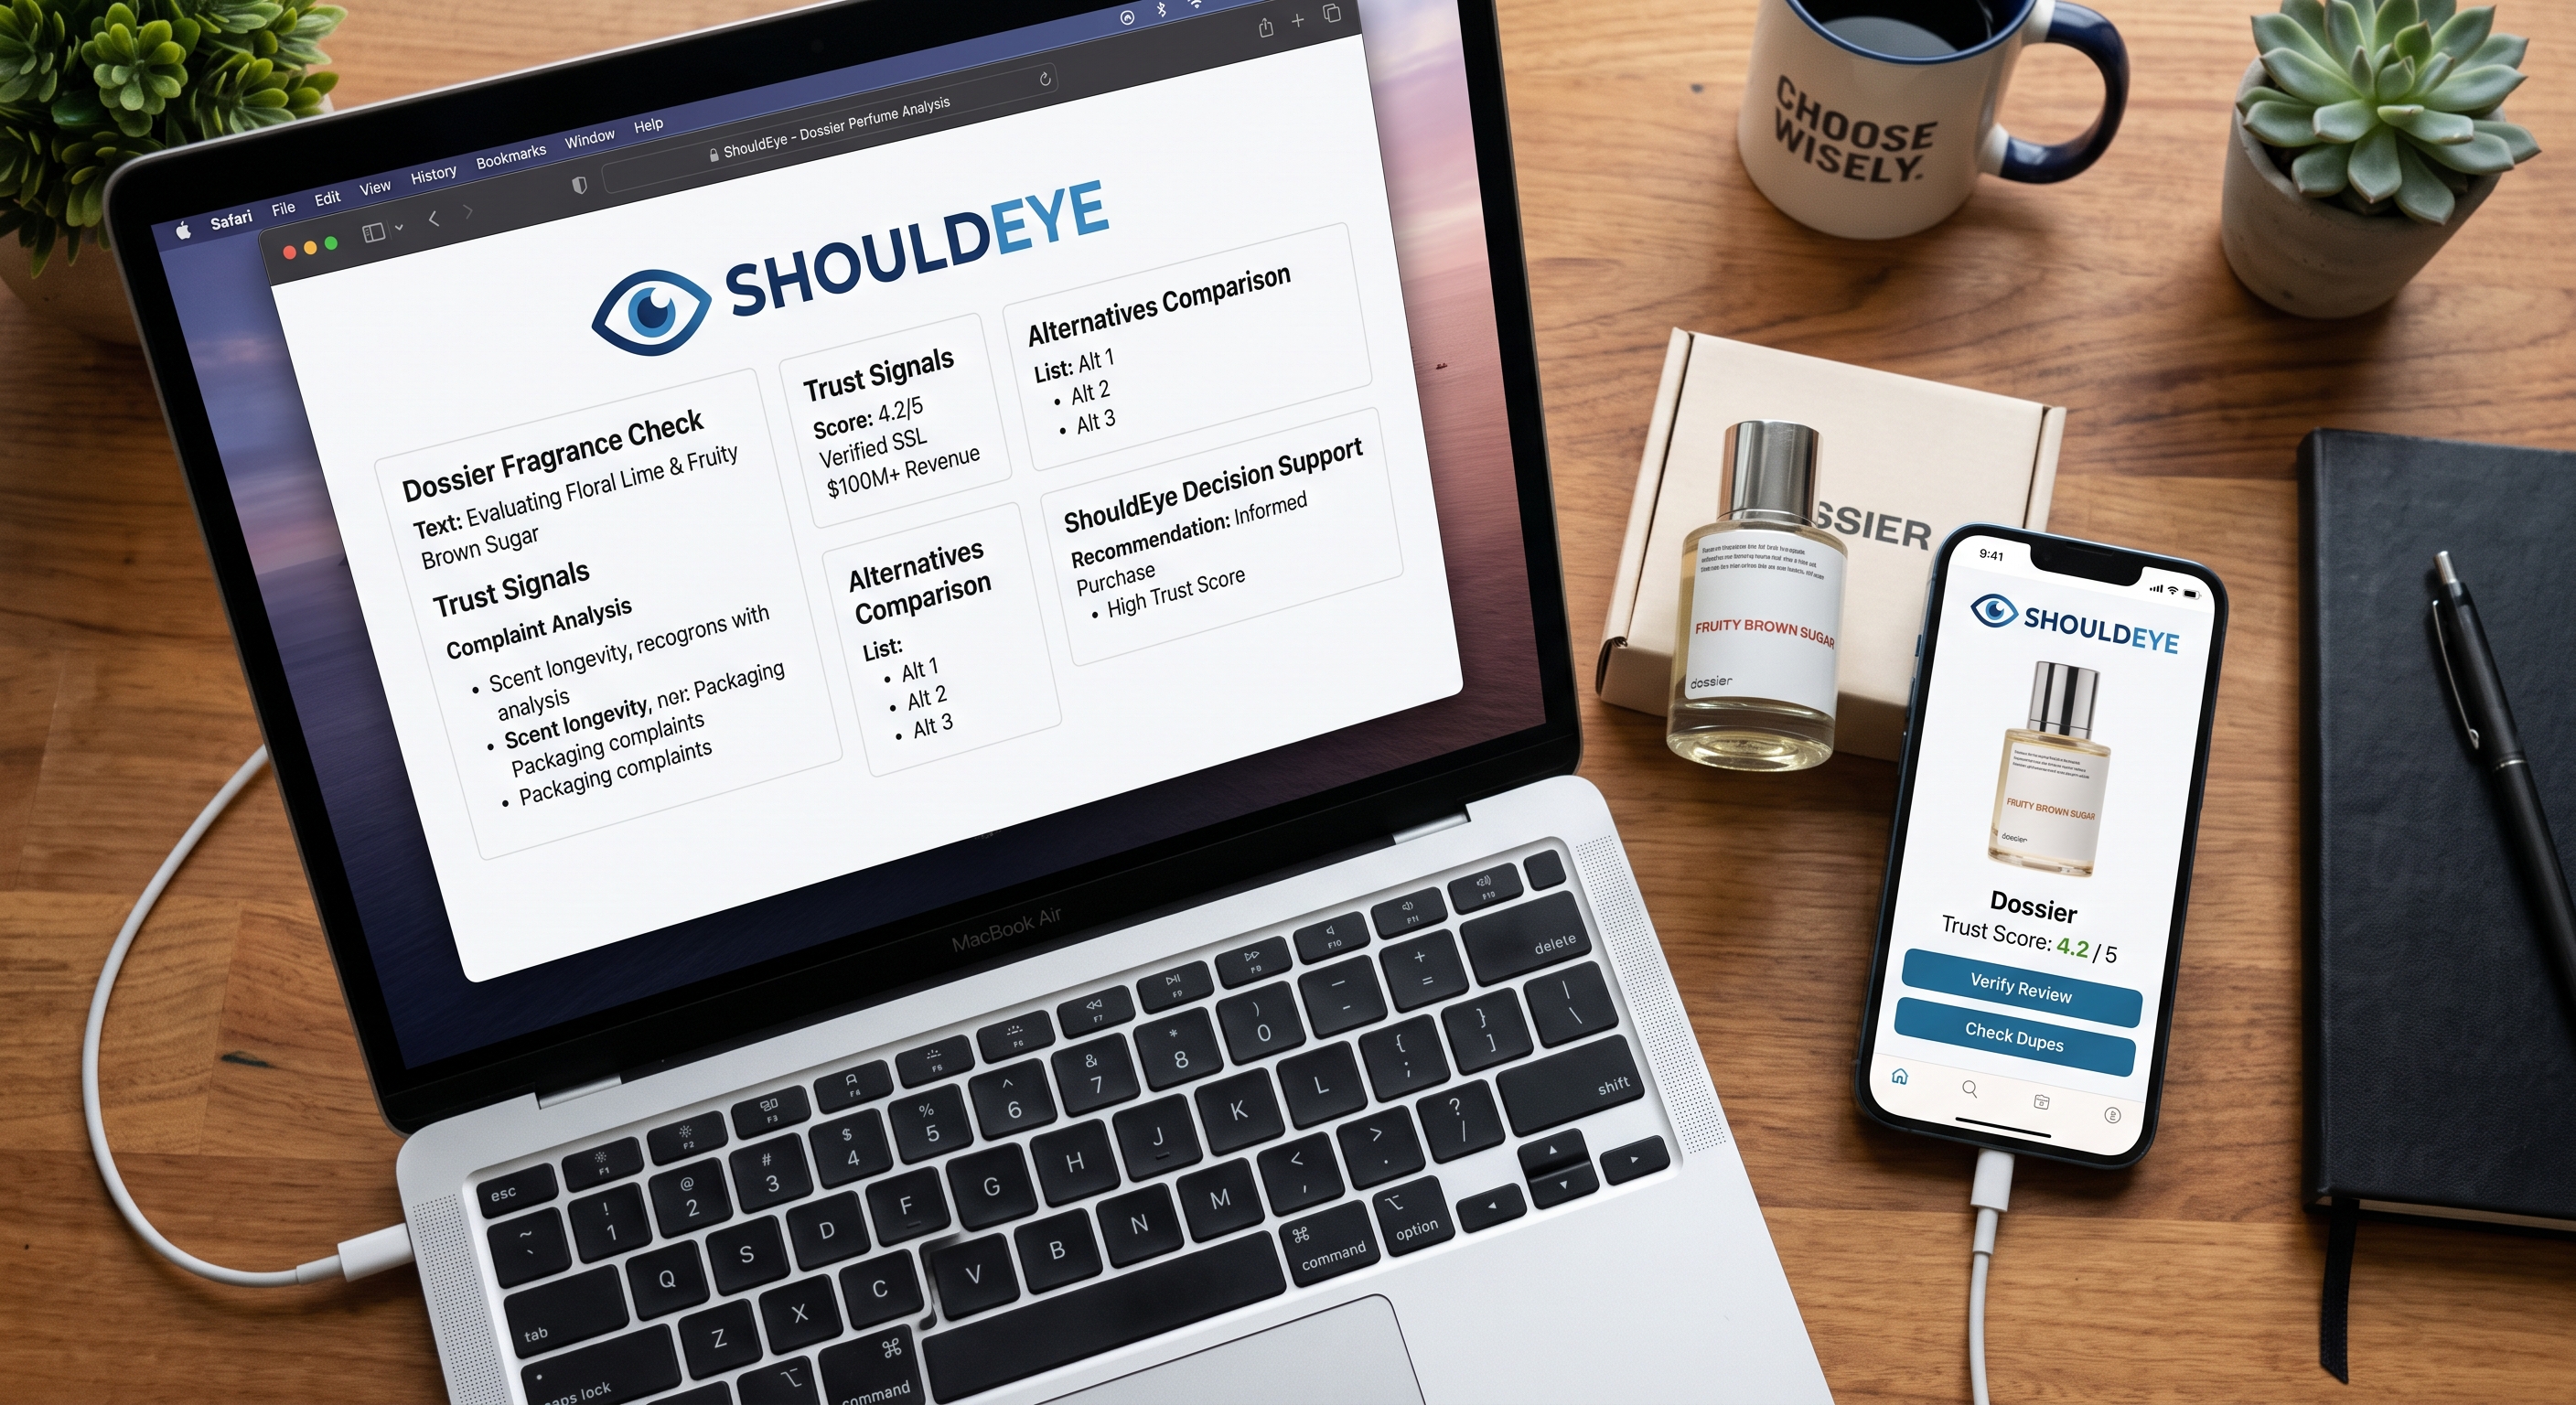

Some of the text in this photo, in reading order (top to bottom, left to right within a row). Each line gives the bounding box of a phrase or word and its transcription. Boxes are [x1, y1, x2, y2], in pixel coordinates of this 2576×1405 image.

[1776, 74, 1938, 153] CHOOSE
[724, 136, 787, 157] ShouldEye
[800, 123, 844, 140] Dossier
[849, 111, 898, 129] Perfume
[903, 99, 950, 117] Analysis
[1775, 106, 1924, 183] WISELY.
[211, 119, 663, 230] Safari File Edit View History Bookmarks Window Help
[726, 180, 1110, 316] SHOULDEYE
[1029, 267, 1291, 347] Alternatives Comparison
[803, 349, 954, 402] Trust Signals
[1035, 349, 1113, 383] List: Alt 1
[1072, 380, 1110, 405] Alt 2
[814, 396, 923, 439] Score: 4.2/5
[1079, 409, 1115, 434] Alt 3
[402, 409, 704, 502] Dossier Fragrance Check
[819, 428, 928, 468] Verified SSL
[828, 448, 980, 499] $100M+ Revenue
[1065, 438, 1363, 532] ShouldEye Decision Support
[413, 446, 737, 539] Text: Evaluating Floral Lime & Fruity
[1071, 490, 1307, 568] Recommendation: Informed
[422, 528, 538, 570] Brown Sugar
[1980, 549, 2002, 561] 9:41
[850, 543, 983, 593] Alternatives
[1077, 565, 1154, 596] Purchase
[433, 562, 589, 617] Trust Signals
[856, 575, 991, 624] Comparison
[1108, 570, 1245, 617] High Trust Score
[447, 598, 632, 659] Complaint Analysis
[1695, 619, 1835, 649] FRUITY BROWN SUGAR
[2024, 607, 2179, 654] SHOULDEYE
[490, 605, 769, 692] Scent longevity, recogrons with
[864, 639, 902, 661] List:
[903, 658, 937, 682] Alt 1
[1690, 675, 1733, 689] dossier
[499, 690, 570, 721] analysis
[505, 722, 560, 748] Scent
[563, 700, 651, 734] longevity,
[694, 663, 785, 698] Packaging
[909, 685, 947, 711] Alt 2
[915, 713, 952, 738] Alt 3
[512, 714, 704, 778] Packaging complaints
[520, 742, 712, 806] Packaging complaints
[2006, 798, 2096, 820] FRUITY BROWN SUGAR
[1991, 891, 2077, 923] Dossier
[951, 907, 1061, 953] MacBook Air
[1943, 915, 2117, 963] Trust Score: 4.2 / 5
[1328, 940, 1341, 949] F10
[1536, 936, 1576, 954] delete
[1971, 972, 2072, 1003] Verify Review
[1258, 1024, 1271, 1041] 0
[1966, 1023, 2064, 1052] Check Dupes
[1175, 1051, 1188, 1068] 8
[1090, 1076, 1101, 1093] 7
[1315, 1077, 1329, 1094] L
[1599, 1077, 1630, 1095] shift
[1008, 1101, 1022, 1118] 6
[1231, 1100, 1248, 1121] K
[927, 1125, 939, 1142] 5
[1154, 1127, 1163, 1145] J
[848, 1150, 859, 1165] 4
[1067, 1152, 1084, 1173] H
[491, 1187, 516, 1201] esc
[767, 1175, 779, 1192] 3
[984, 1177, 1000, 1196] G
[687, 1199, 699, 1217] 2
[900, 1196, 911, 1215] F
[1210, 1188, 1230, 1209] M
[607, 1225, 616, 1240] 1
[820, 1222, 834, 1239] D
[1132, 1214, 1148, 1234] N
[1397, 1220, 1438, 1240] option
[740, 1246, 754, 1262] S
[1050, 1241, 1065, 1260] B
[1303, 1240, 1366, 1271] command
[660, 1271, 675, 1287] Q
[966, 1265, 980, 1283] V
[873, 1281, 887, 1297] C
[792, 1303, 808, 1323] X
[525, 1327, 547, 1342] tab
[712, 1329, 726, 1348] Z
[545, 1382, 611, 1405] aps lock
